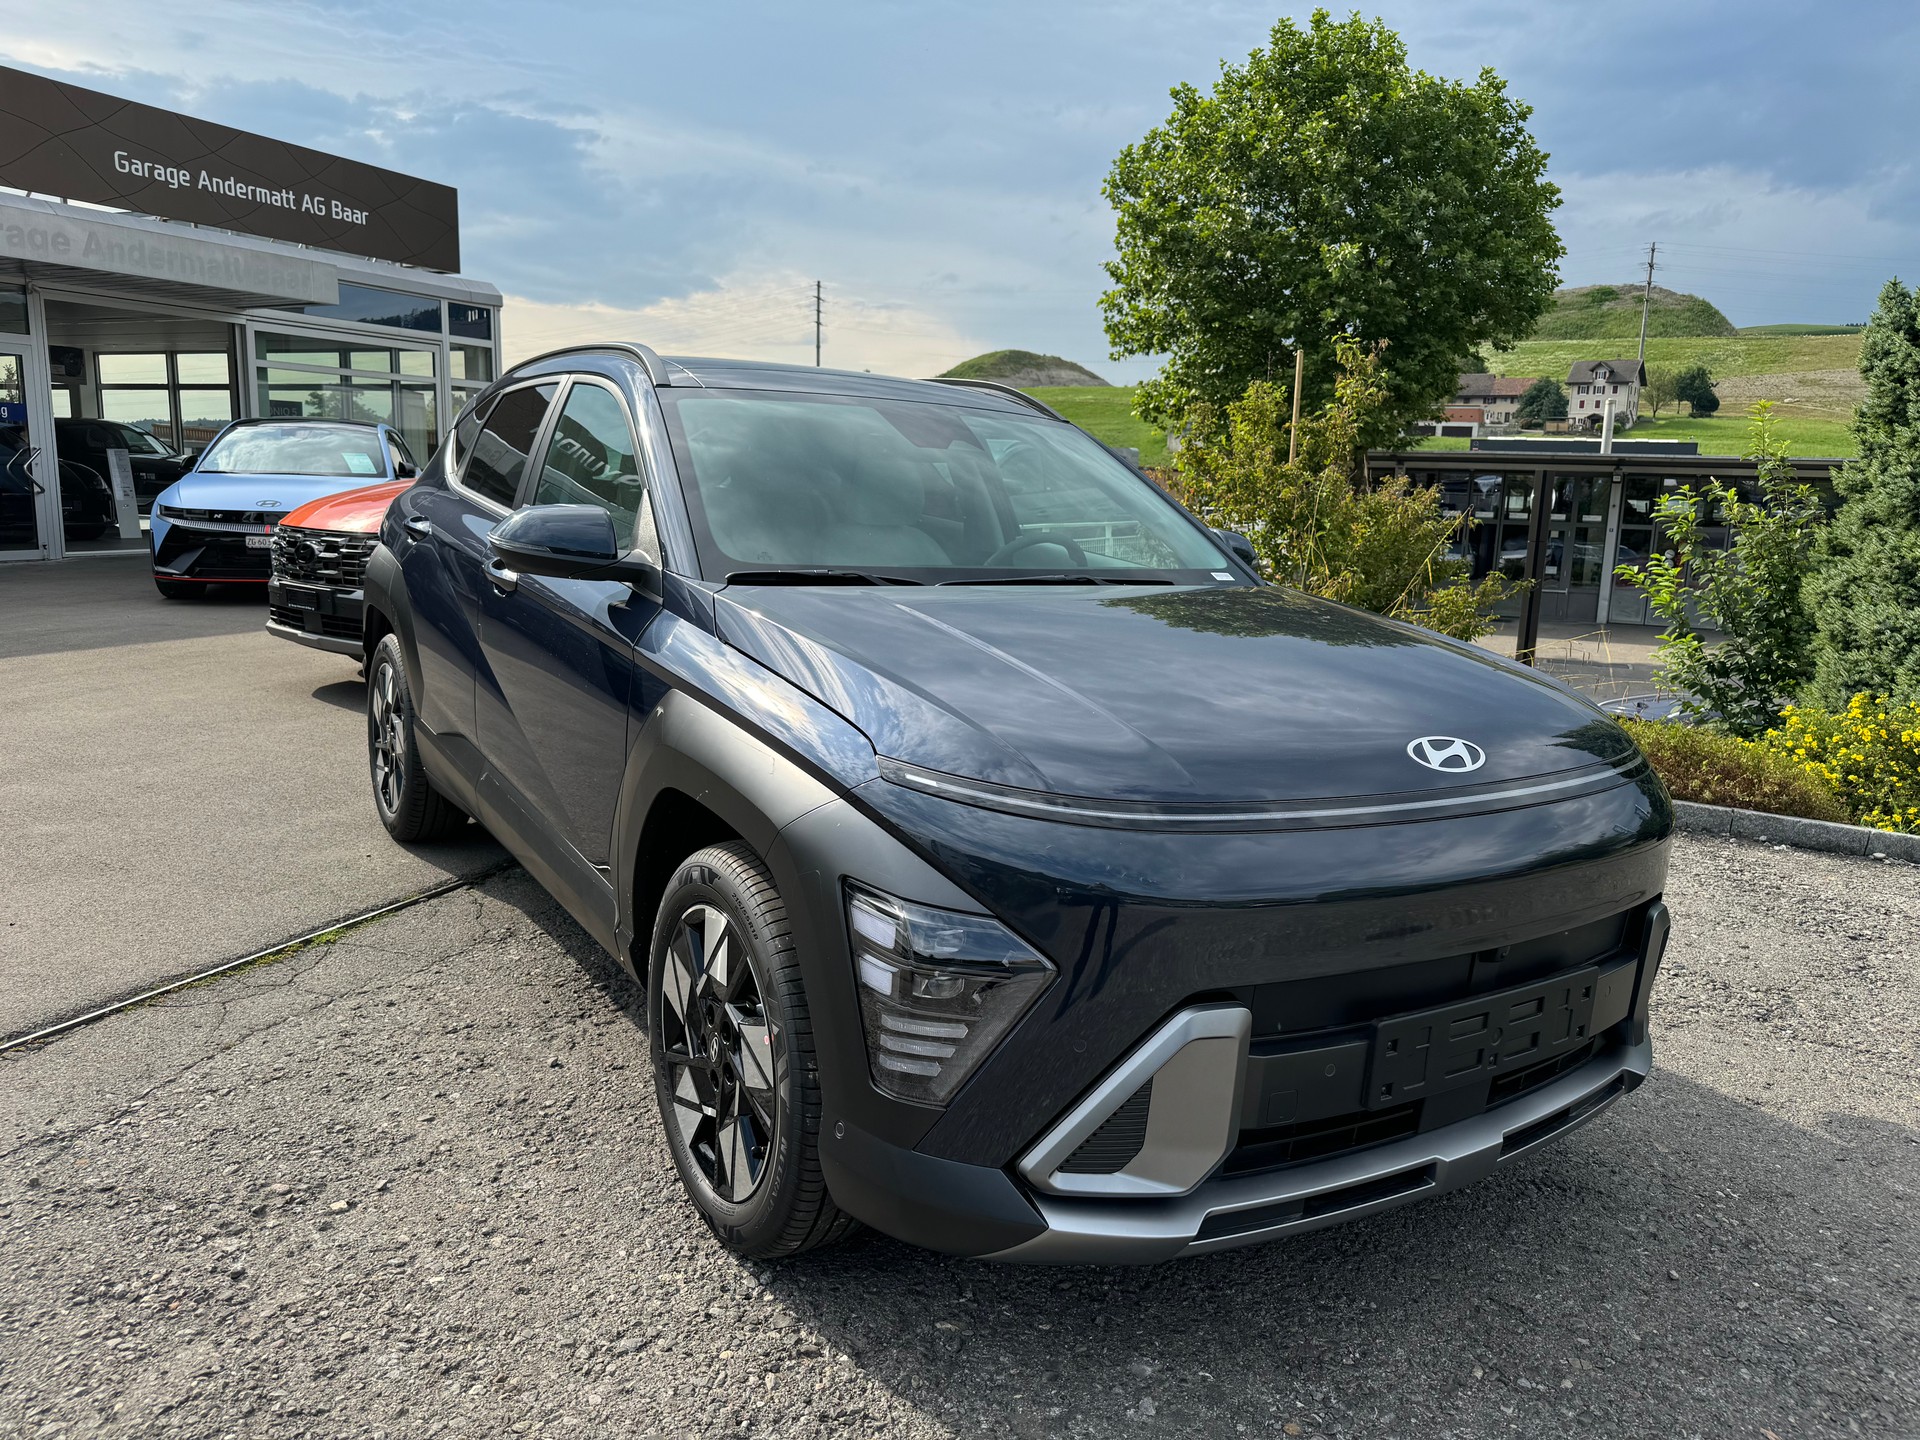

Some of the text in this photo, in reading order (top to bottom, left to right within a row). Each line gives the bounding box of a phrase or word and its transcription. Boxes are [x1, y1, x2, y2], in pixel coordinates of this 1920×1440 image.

[114, 150, 369, 225] Garage Andermatt AG Baar
[247, 537, 257, 546] ZG
